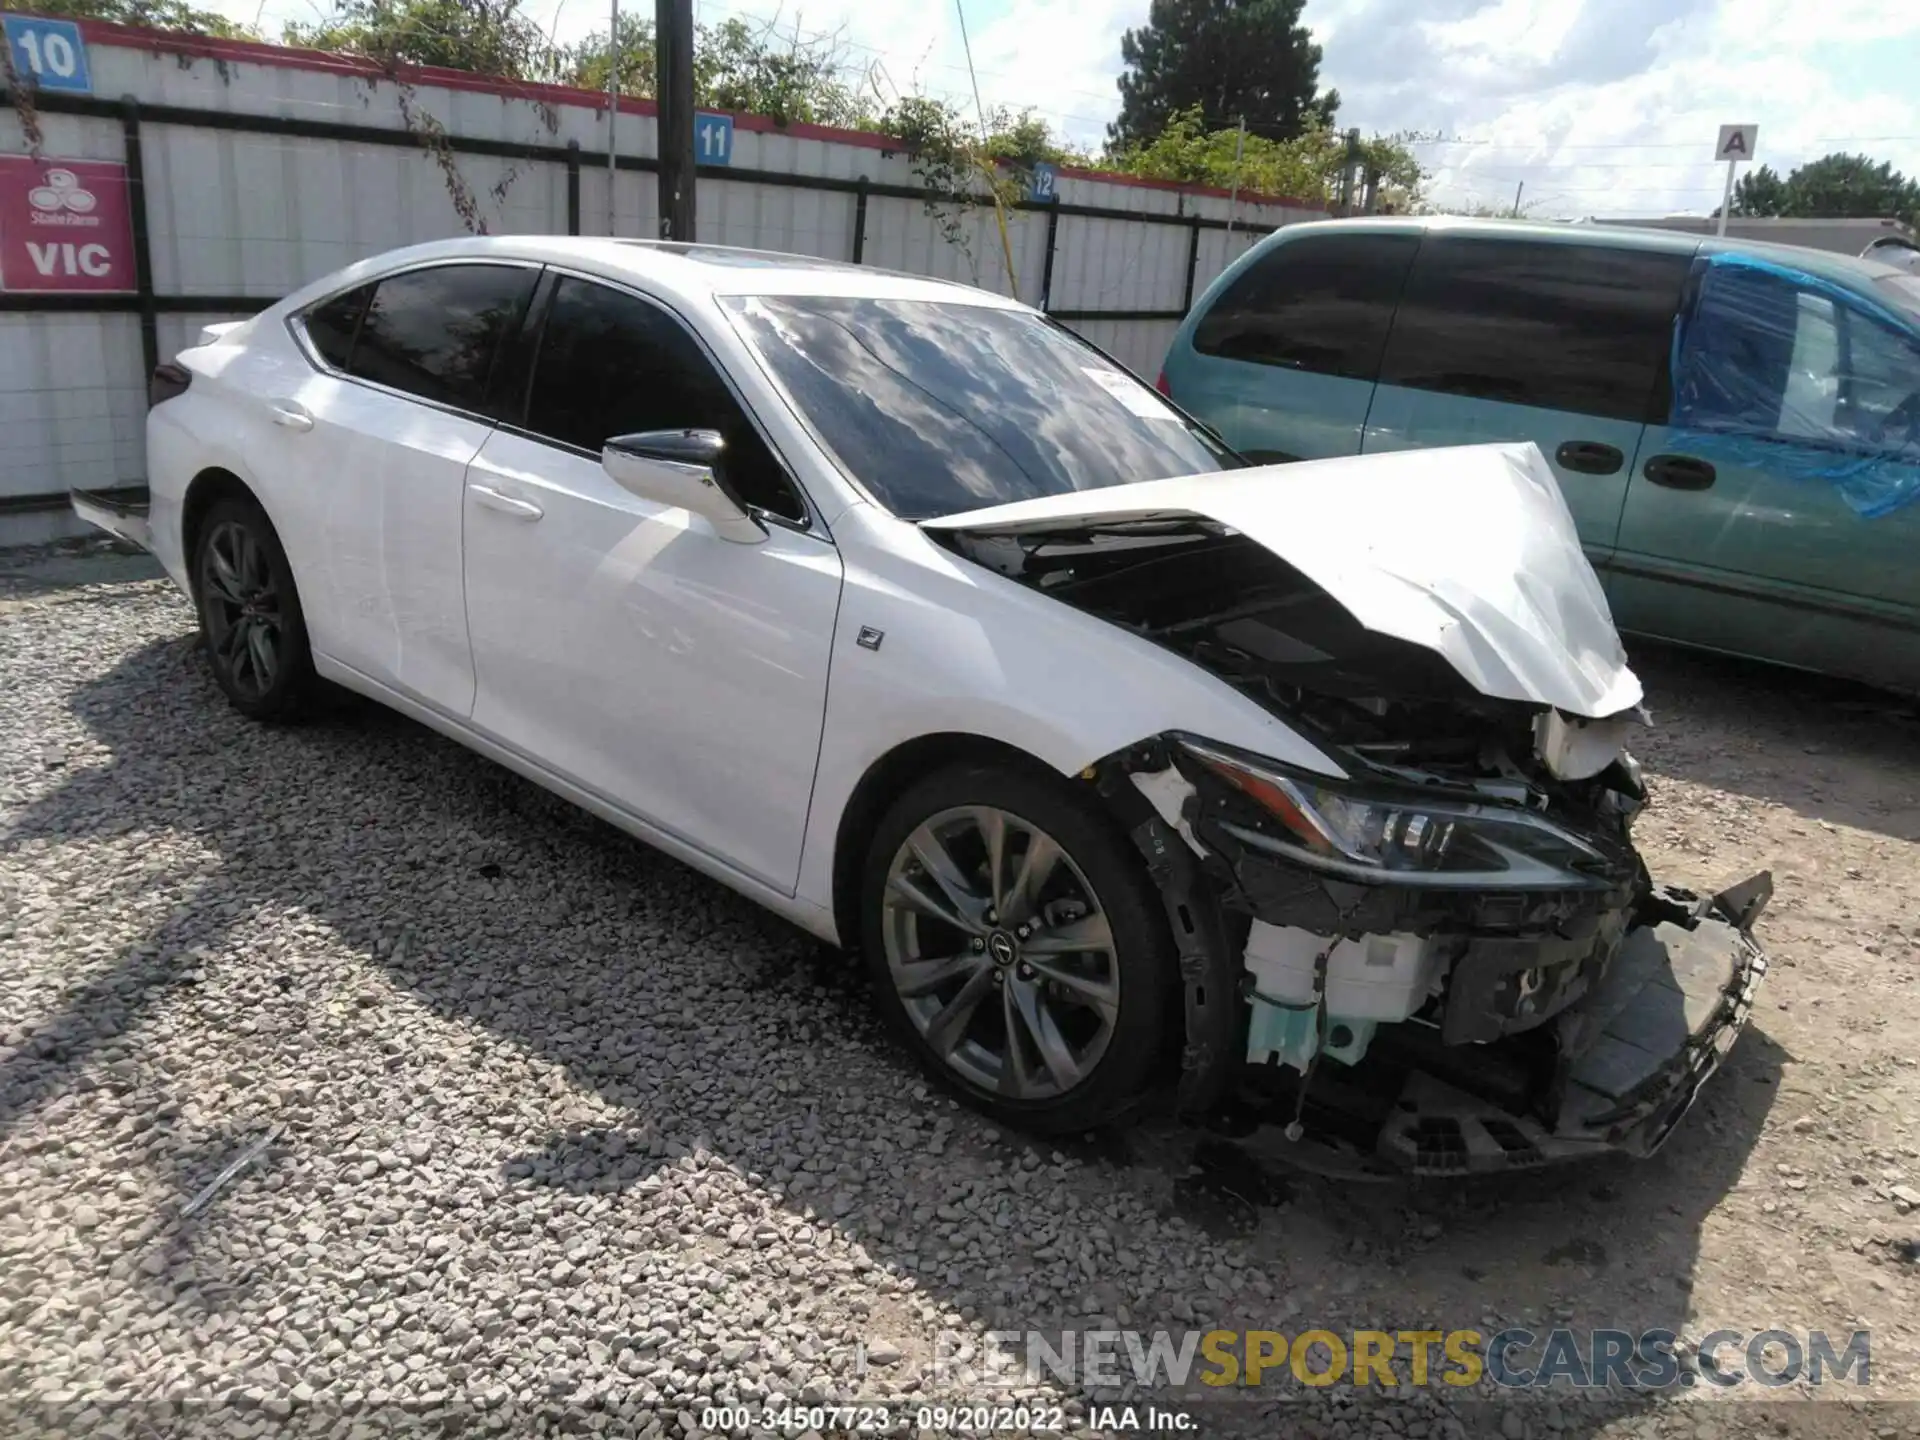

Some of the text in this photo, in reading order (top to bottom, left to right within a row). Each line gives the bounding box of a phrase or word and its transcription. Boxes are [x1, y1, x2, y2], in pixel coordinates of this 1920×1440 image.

[18, 29, 76, 78] 10
[701, 123, 726, 157] 11
[1722, 131, 1746, 154] A
[1036, 170, 1052, 196] 12
[25, 241, 112, 277] VIC
